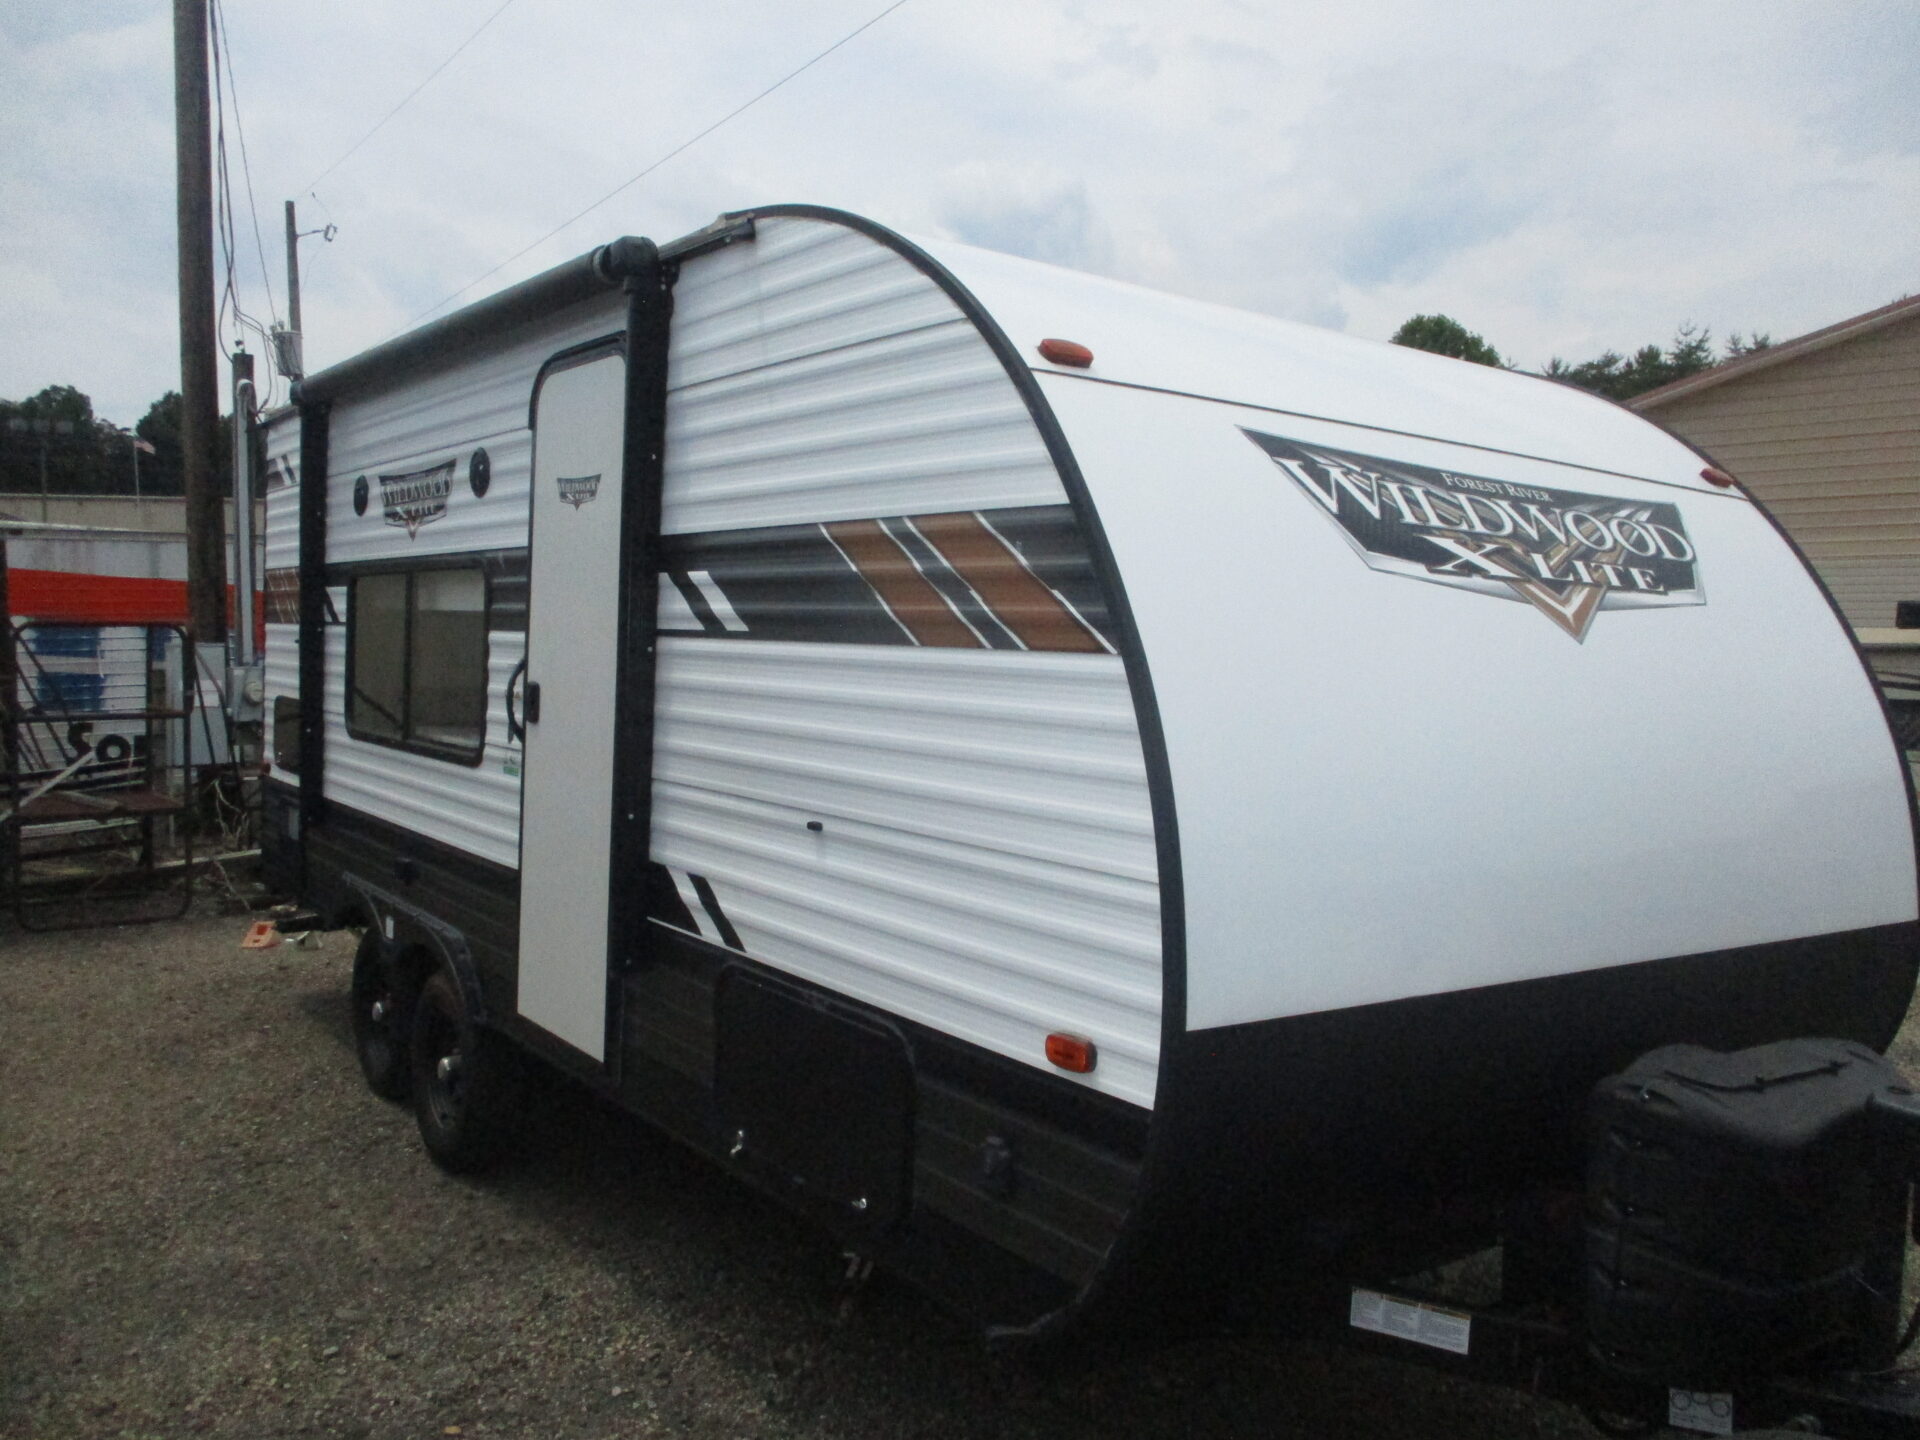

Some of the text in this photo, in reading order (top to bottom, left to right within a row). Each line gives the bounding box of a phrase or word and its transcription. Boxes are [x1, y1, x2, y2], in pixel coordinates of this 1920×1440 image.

[380, 470, 453, 506] WILDWOOD
[1272, 456, 1696, 563] WILDWOOD
[1440, 472, 1553, 502] FOREST RIVER
[1414, 533, 1666, 593] X LITE
